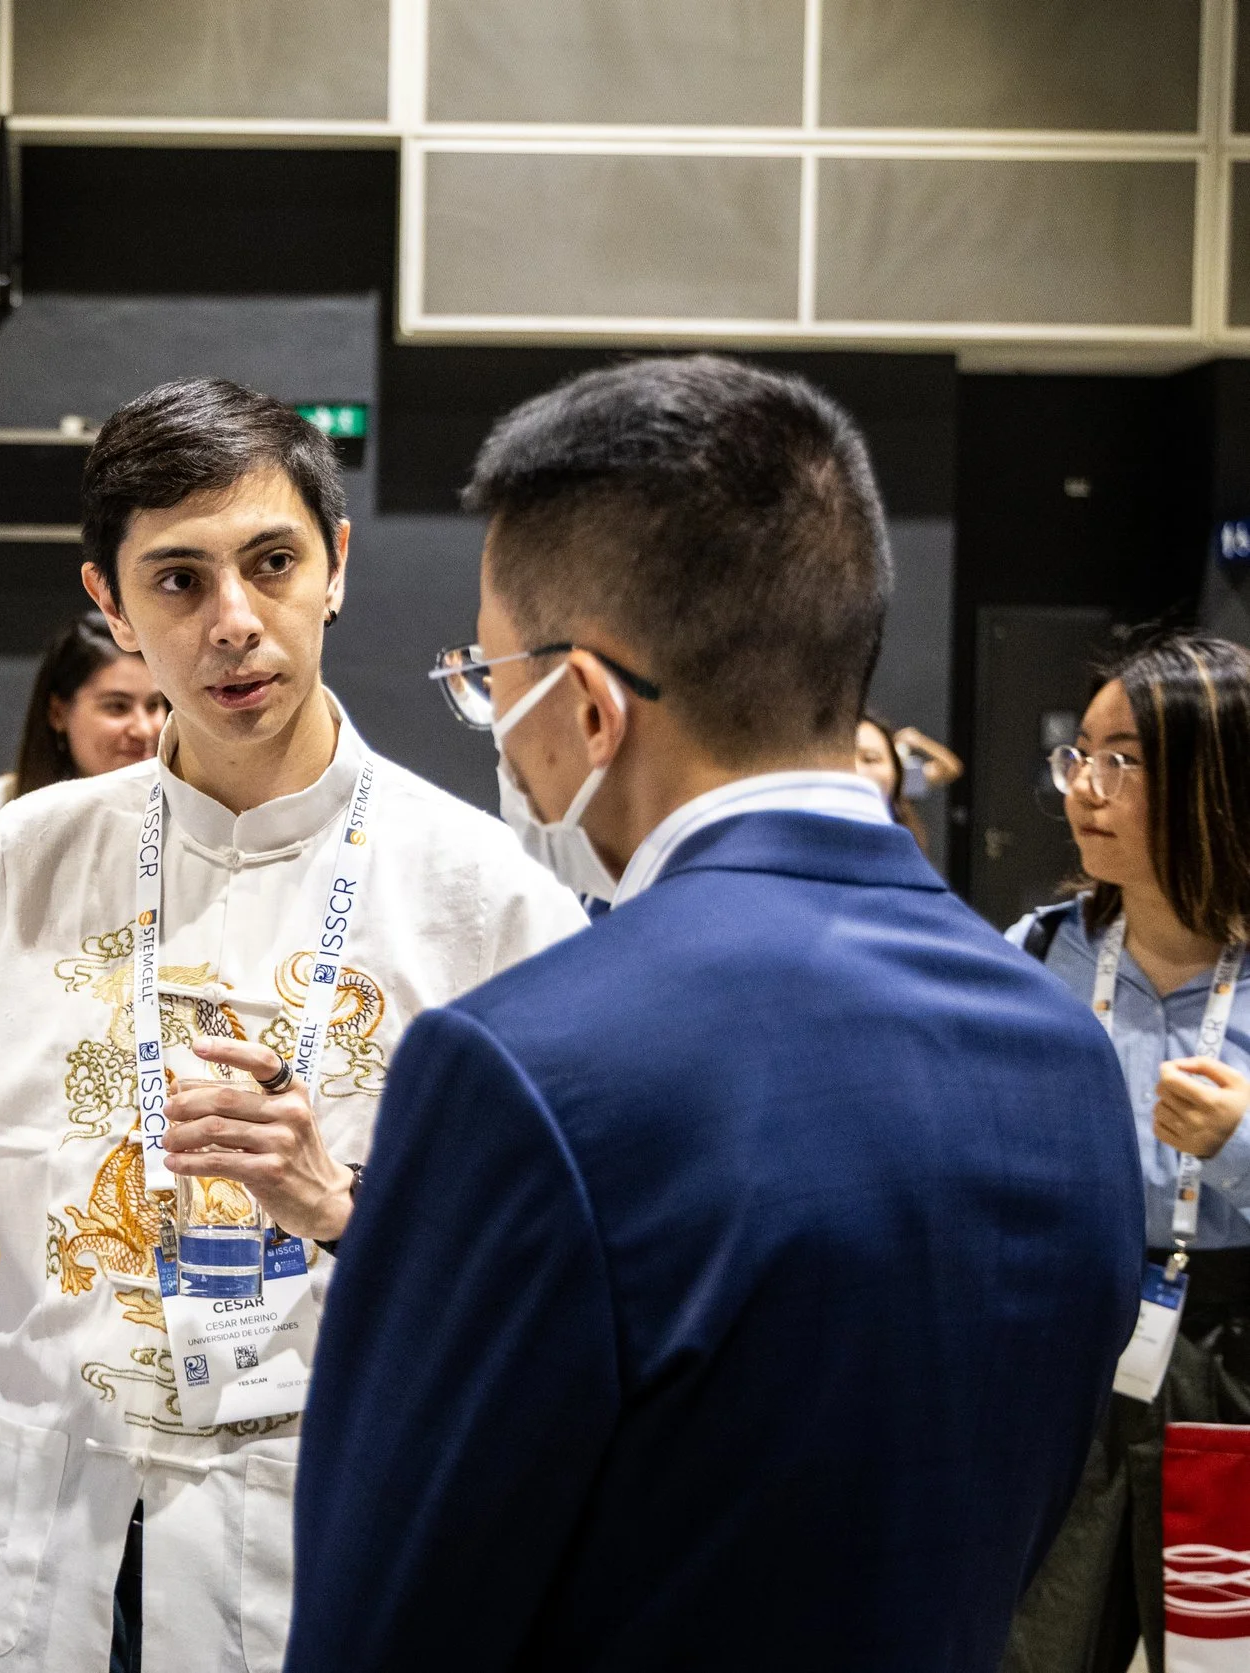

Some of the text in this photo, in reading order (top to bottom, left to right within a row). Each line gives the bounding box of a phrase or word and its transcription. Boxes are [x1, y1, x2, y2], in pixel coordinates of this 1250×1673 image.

[139, 806, 160, 879] ISSCR
[319, 877, 357, 957] ISSCR
[141, 1069, 166, 1150] ISSCR
[275, 1244, 301, 1256] ISSCR
[213, 1296, 265, 1314] CESAR
[205, 1312, 278, 1332] CESAR MERINO
[187, 1321, 299, 1347] UNIVERSIDAD DE LOS ANDES
[251, 1377, 268, 1385] SCAN
